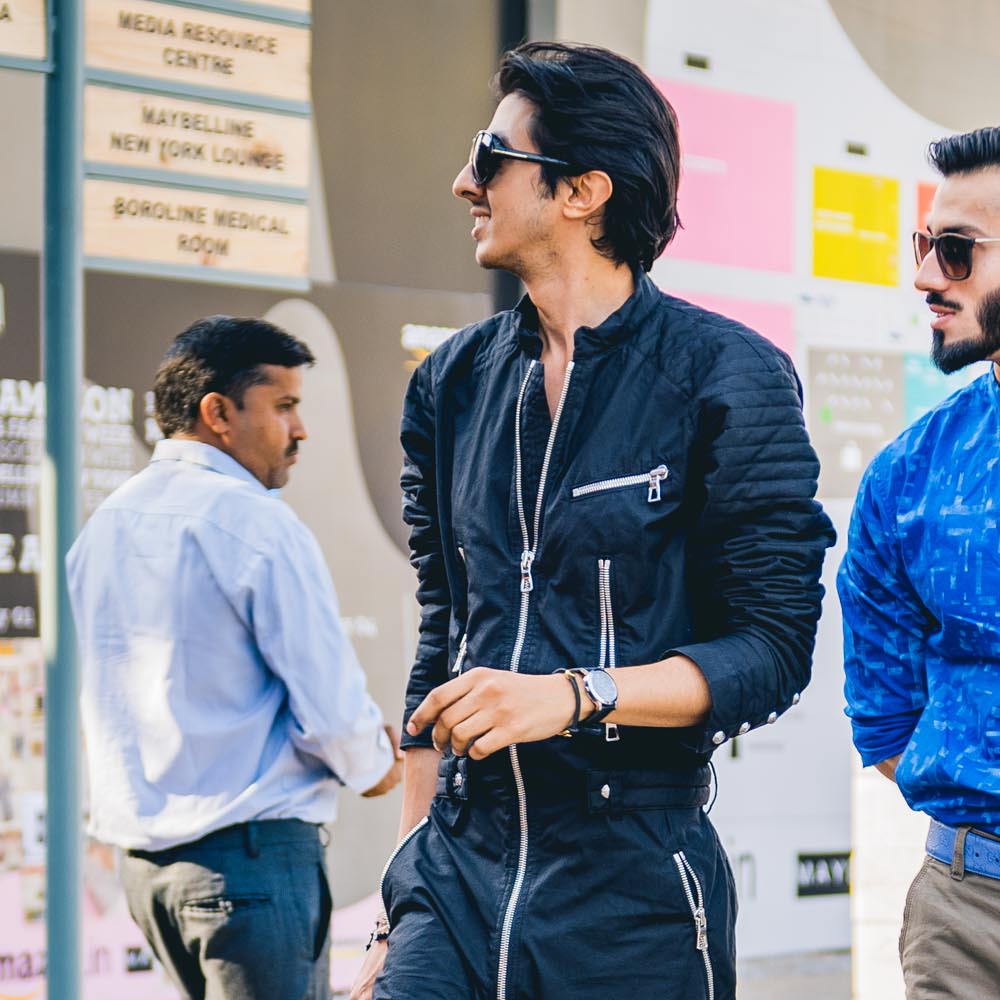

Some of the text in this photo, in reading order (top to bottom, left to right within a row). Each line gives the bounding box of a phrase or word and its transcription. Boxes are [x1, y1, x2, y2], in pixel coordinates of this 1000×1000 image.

[118, 10, 278, 55] MEDIA RESOURCE
[163, 48, 235, 75] CENTRE
[142, 106, 255, 138] MAYBELLINE
[109, 132, 285, 171] NEW YORK LOUNGE
[113, 197, 289, 235] BOROLINE MEDICAL
[177, 234, 229, 256] ROOM
